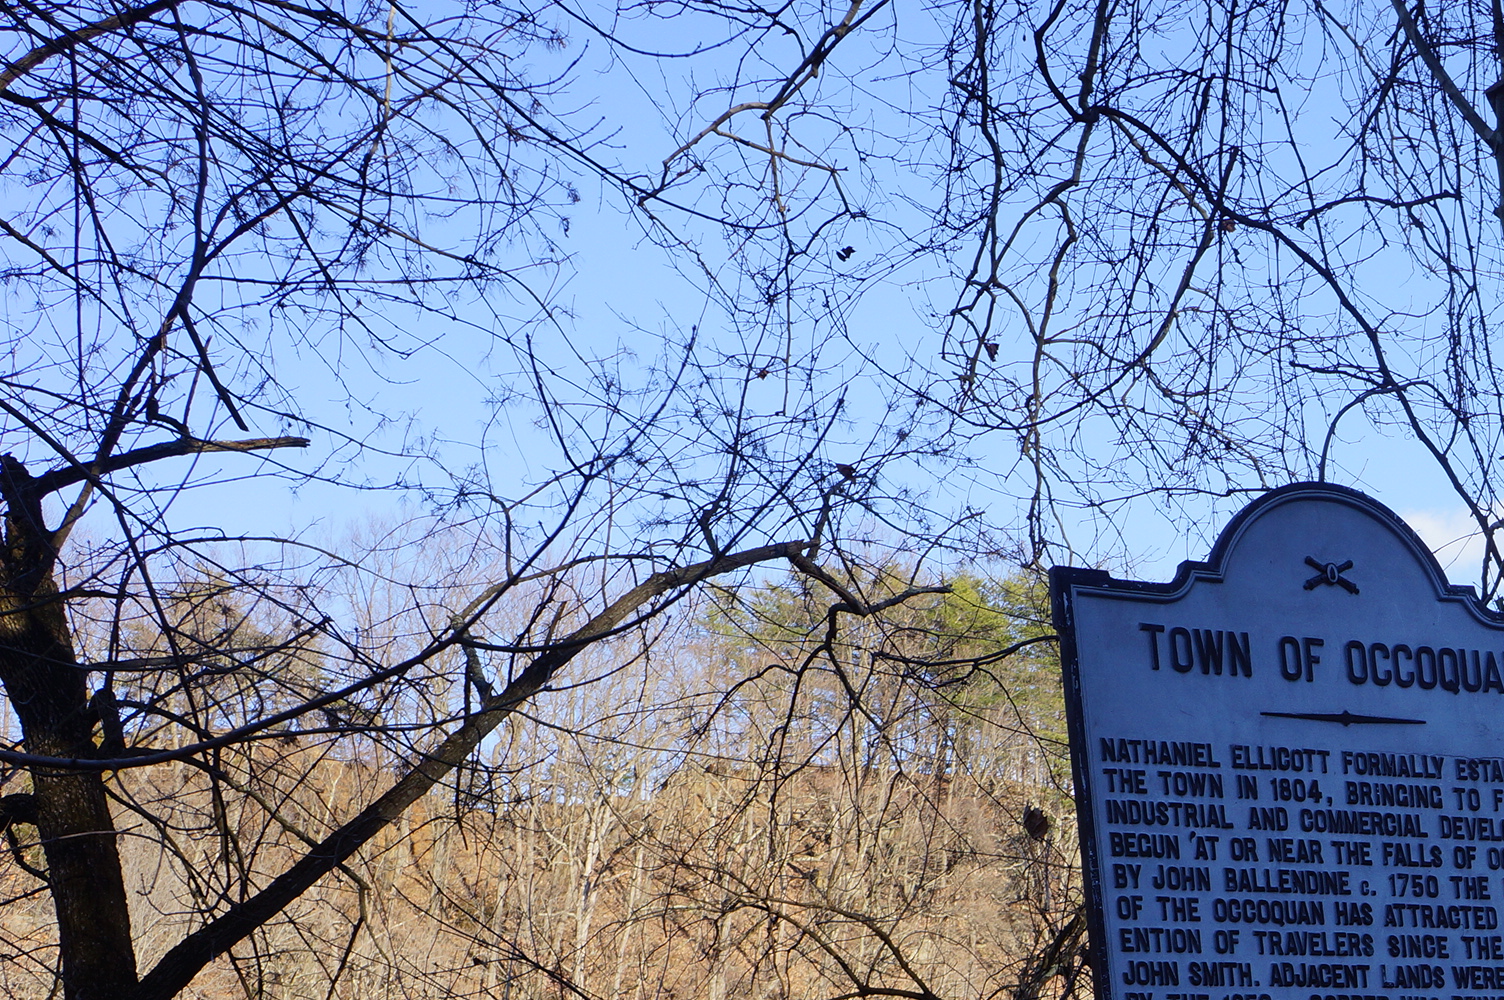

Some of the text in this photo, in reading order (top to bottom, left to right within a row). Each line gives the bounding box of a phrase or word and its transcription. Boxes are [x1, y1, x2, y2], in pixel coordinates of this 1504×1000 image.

[1138, 622, 1253, 679] TOWN
[1277, 636, 1324, 683] OF
[1099, 737, 1221, 769] NATHANIEL
[1229, 744, 1330, 774] ELLICOTT
[1341, 750, 1444, 780] FORMALLY
[1102, 768, 1148, 795] THE
[1157, 770, 1224, 799] TOWN
[1235, 774, 1258, 801] IN
[1269, 777, 1333, 807] 1804,
[1344, 781, 1443, 809] BRINGING
[1451, 787, 1481, 813] TO
[1105, 799, 1234, 831] INDUSTRIAL
[1247, 806, 1289, 832] AND
[1299, 808, 1429, 838] COMMERCIAL
[1109, 832, 1180, 860] BEGUN
[1229, 837, 1259, 862] OR
[1266, 838, 1324, 864] NEAR
[1331, 840, 1373, 867] THE
[1381, 841, 1443, 868] FALLS
[1452, 845, 1477, 870] OF
[1112, 863, 1142, 889] BY
[1152, 864, 1211, 892] JOHN
[1222, 867, 1352, 896] BALLENDINE
[1388, 873, 1439, 899] 1750
[1448, 876, 1491, 901] THE
[1116, 895, 1143, 921] OF
[1155, 896, 1201, 923] THE
[1212, 898, 1325, 928] OCCOQUAN
[1333, 901, 1374, 927] HAS
[1383, 903, 1498, 931] ATTRACTED
[1118, 927, 1202, 954] ENTION
[1213, 929, 1240, 955] OF
[1252, 930, 1374, 958] TRAVELERS
[1386, 934, 1450, 959] SINCE
[1460, 935, 1504, 961] THE
[1122, 960, 1179, 987] JOHN
[1187, 961, 1260, 988] SMITH.
[1269, 962, 1370, 989] ADJACENT
[1379, 964, 1445, 990] LANDS
